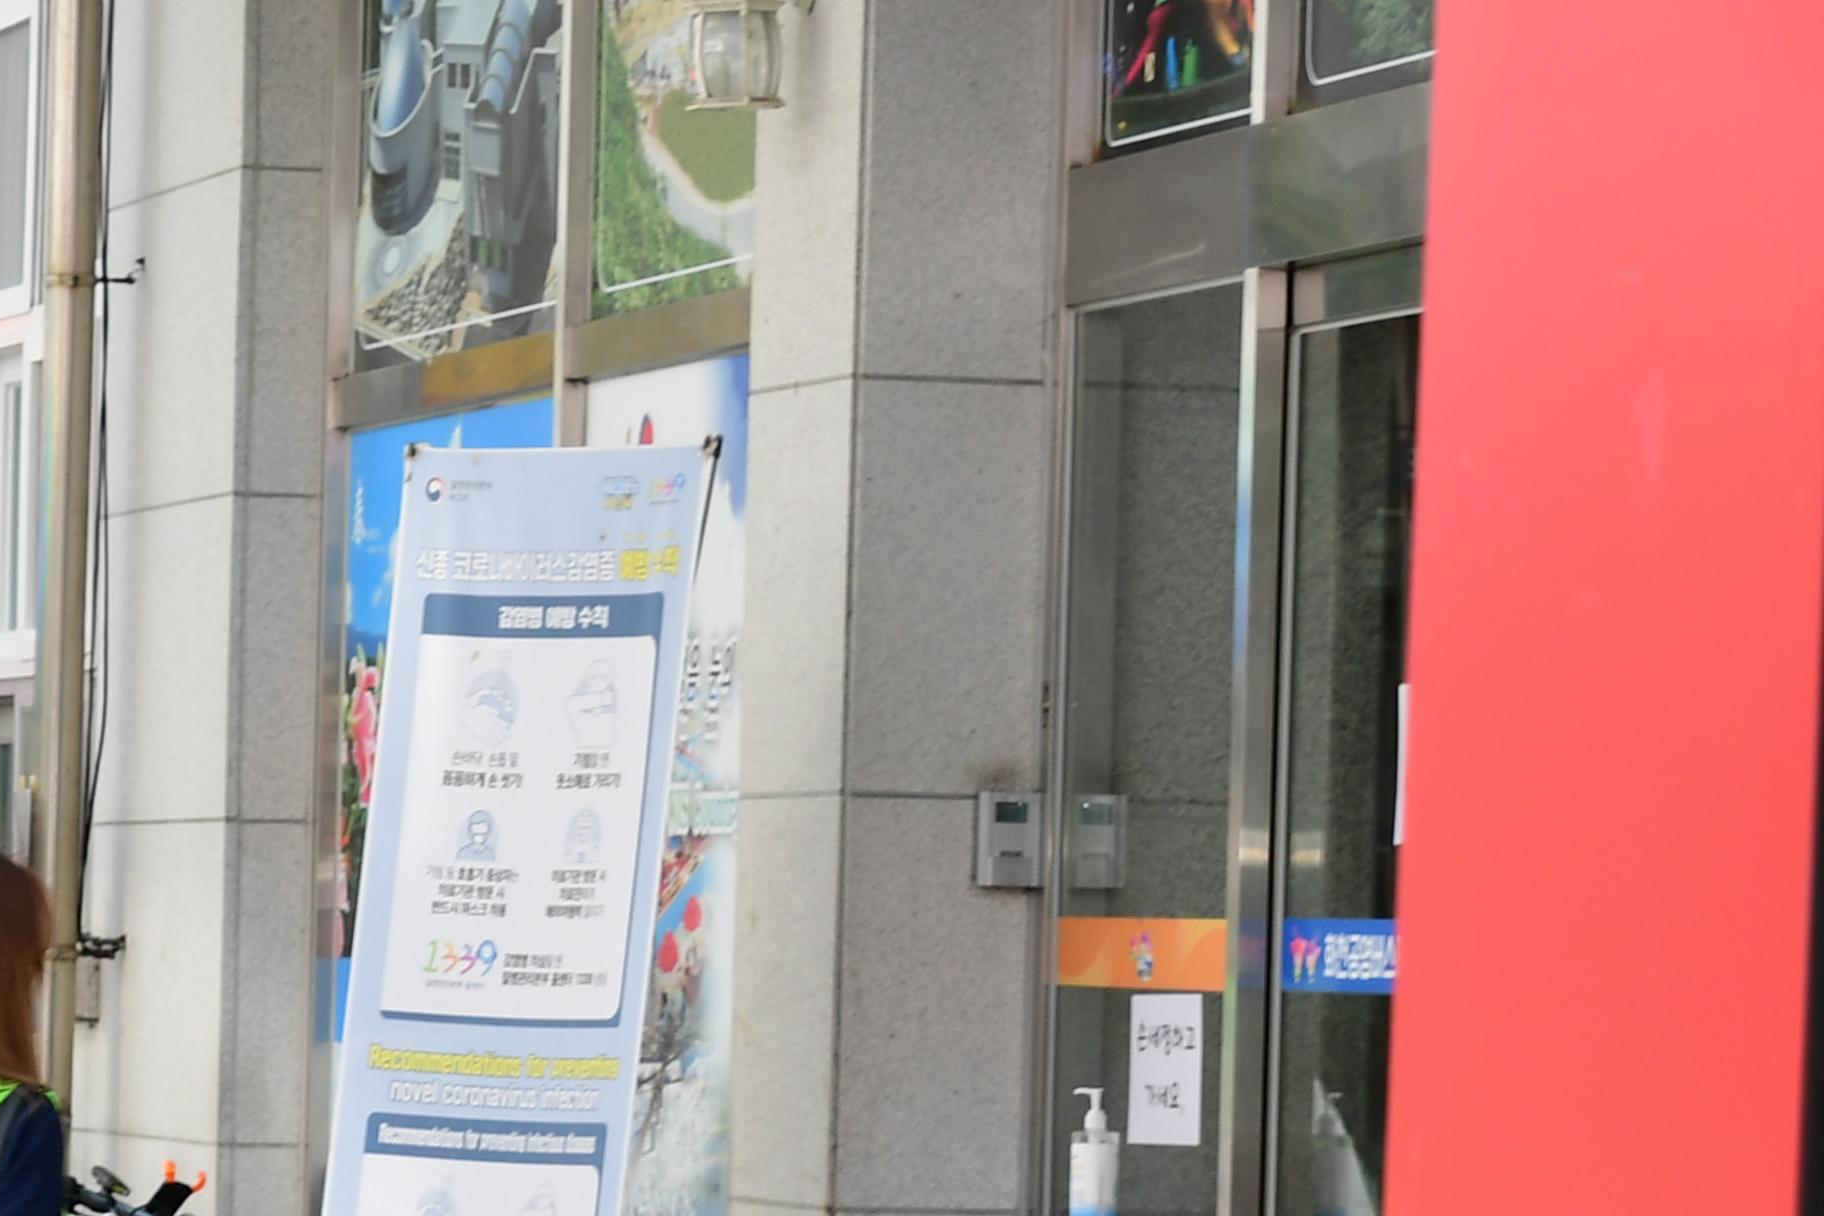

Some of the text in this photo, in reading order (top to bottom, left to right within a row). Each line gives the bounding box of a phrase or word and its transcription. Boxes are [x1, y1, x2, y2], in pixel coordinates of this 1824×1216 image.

[422, 939, 498, 977] 1339
[369, 1043, 522, 1078] Recommendations
[389, 1080, 437, 1102] novel
[442, 1083, 537, 1109] coronavirus
